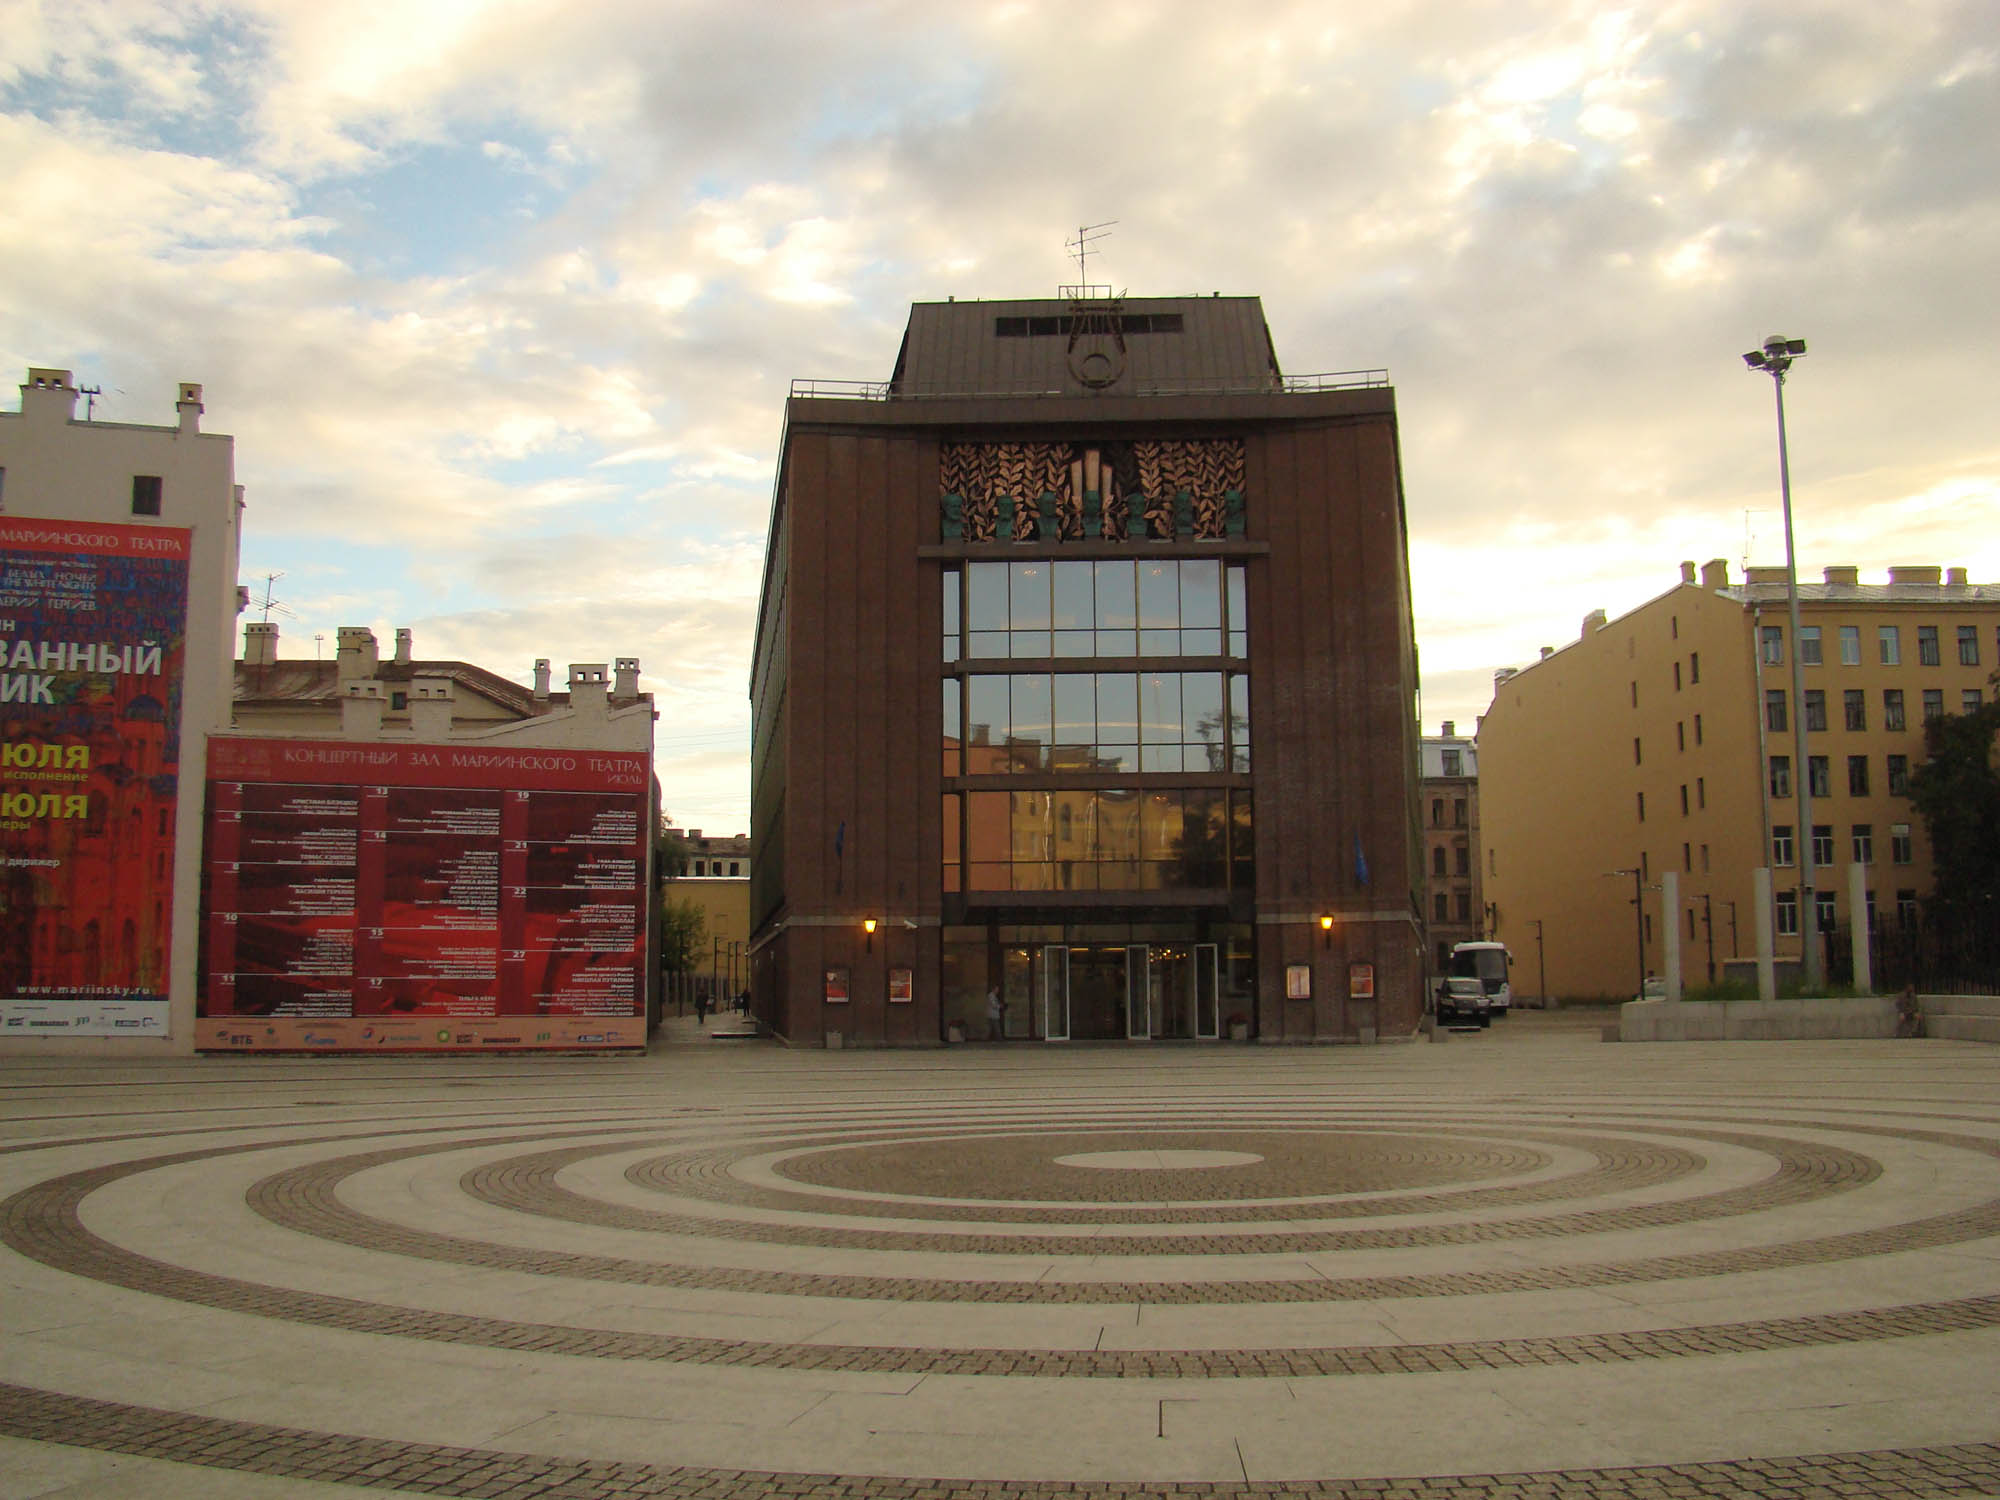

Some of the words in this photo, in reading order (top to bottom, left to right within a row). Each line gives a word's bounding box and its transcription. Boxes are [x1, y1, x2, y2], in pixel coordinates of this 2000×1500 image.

[130, 536, 183, 552] ТЕАТРА
[284, 748, 398, 765] КОНЦЕРТНЫЙ
[408, 751, 440, 767] ЗАЛ
[452, 753, 577, 772] МАРИИНСКОГО
[587, 758, 642, 774] ТЕАТРА
[607, 773, 642, 785] ИЮЛЬ
[515, 841, 528, 849] 21
[513, 950, 525, 959] 27
